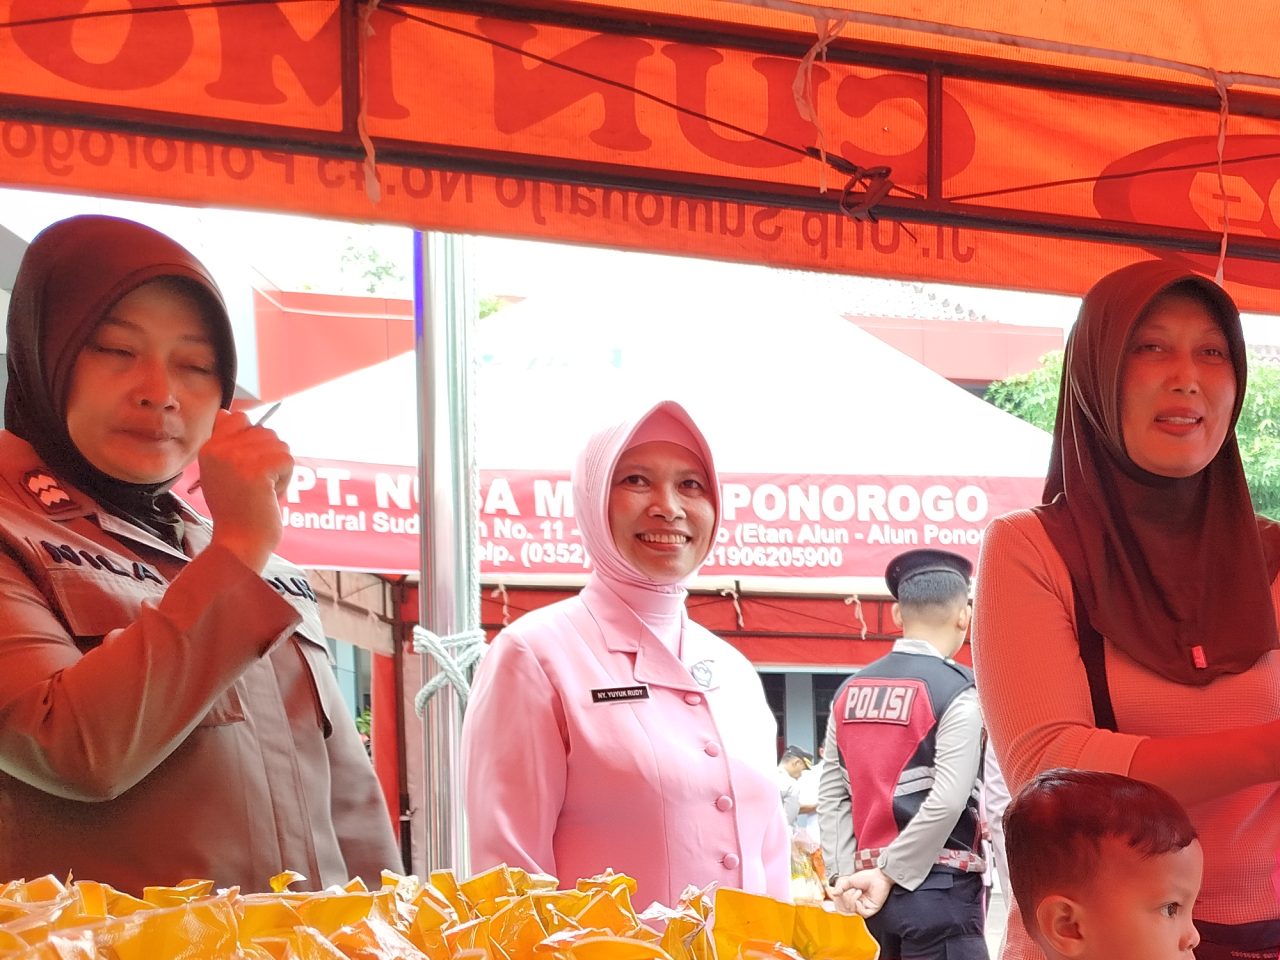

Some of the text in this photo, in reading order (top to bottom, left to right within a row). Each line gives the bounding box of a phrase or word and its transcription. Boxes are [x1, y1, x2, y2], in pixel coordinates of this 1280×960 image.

[287, 465, 359, 507] PT.
[375, 472, 521, 517] NA
[721, 483, 989, 523] PONOROGO
[282, 507, 366, 532] Jendral
[494, 518, 533, 540] No.
[540, 521, 563, 540] 11
[735, 522, 792, 548] (Etan
[796, 523, 849, 544] Alun
[867, 524, 918, 545] Alun
[39, 540, 166, 586] NILA
[477, 544, 515, 566] elp.
[844, 686, 914, 721] POLISI
